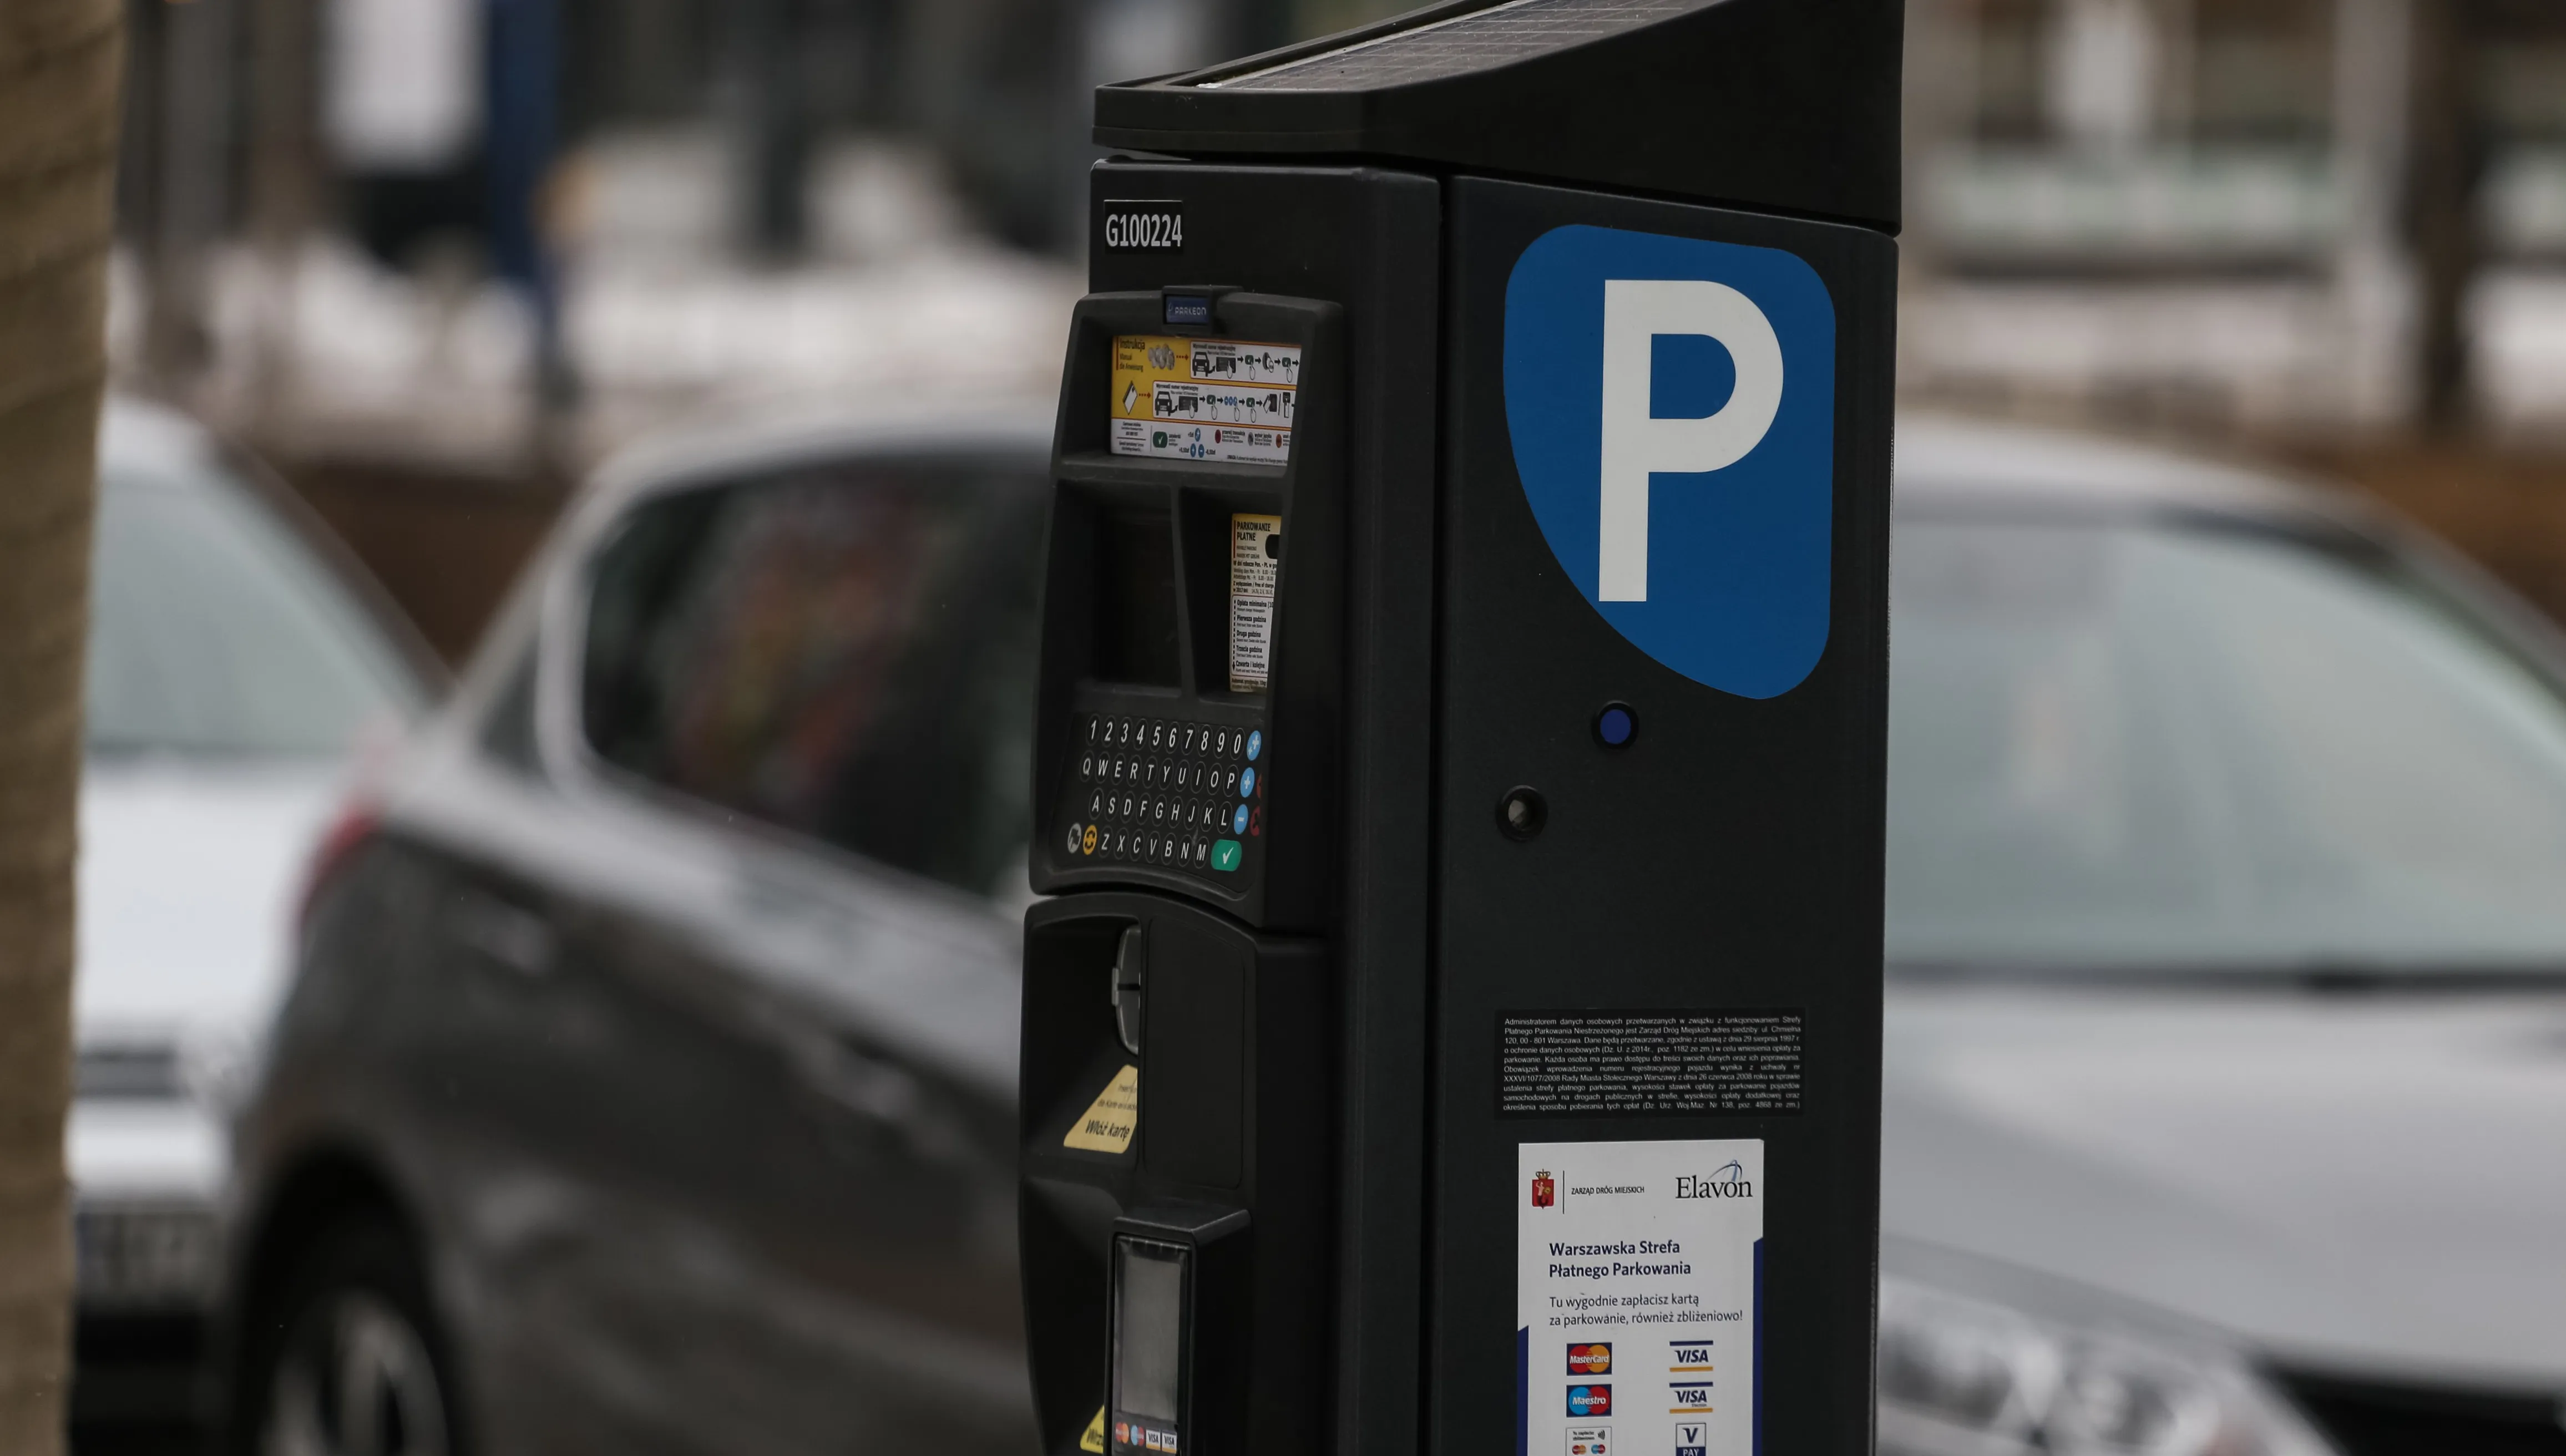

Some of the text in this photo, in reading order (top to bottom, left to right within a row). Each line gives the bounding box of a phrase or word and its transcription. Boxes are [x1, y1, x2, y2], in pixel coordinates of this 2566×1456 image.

[1106, 215, 1182, 246] G100224
[1175, 307, 1206, 315] PARKEON
[1599, 280, 1783, 601] P
[1237, 521, 1271, 531] PARKOWANIE
[1237, 532, 1256, 541] PŁATNE
[1092, 721, 1241, 753] 1 2 3 4 5 6 7 8 9 0
[1084, 758, 1234, 789] Q W E R T Y U I O P
[1092, 796, 1226, 825] A S D F G H J K L
[1102, 834, 1206, 860] Z X C V B N M
[1109, 1123, 1130, 1142] kartę
[1571, 1186, 1594, 1196] ZARZĄD
[1596, 1185, 1613, 1194] DRÓG
[1675, 1175, 1753, 1199] Elavon
[1550, 1240, 1680, 1256] Warszawska Strefa
[1550, 1261, 1691, 1279] Płatnego Parkowania
[1550, 1293, 1699, 1310] Tu wygodnie zapłacisz kartą
[1550, 1310, 1742, 1328] za parkowanie, również zbliżeniowo!
[1570, 1354, 1609, 1364] MasterCard
[1675, 1350, 1708, 1363] VISA
[1572, 1396, 1606, 1405] Maestro
[1674, 1391, 1707, 1403] VISA
[1148, 1433, 1158, 1443] VISA
[1165, 1435, 1174, 1445] VISA
